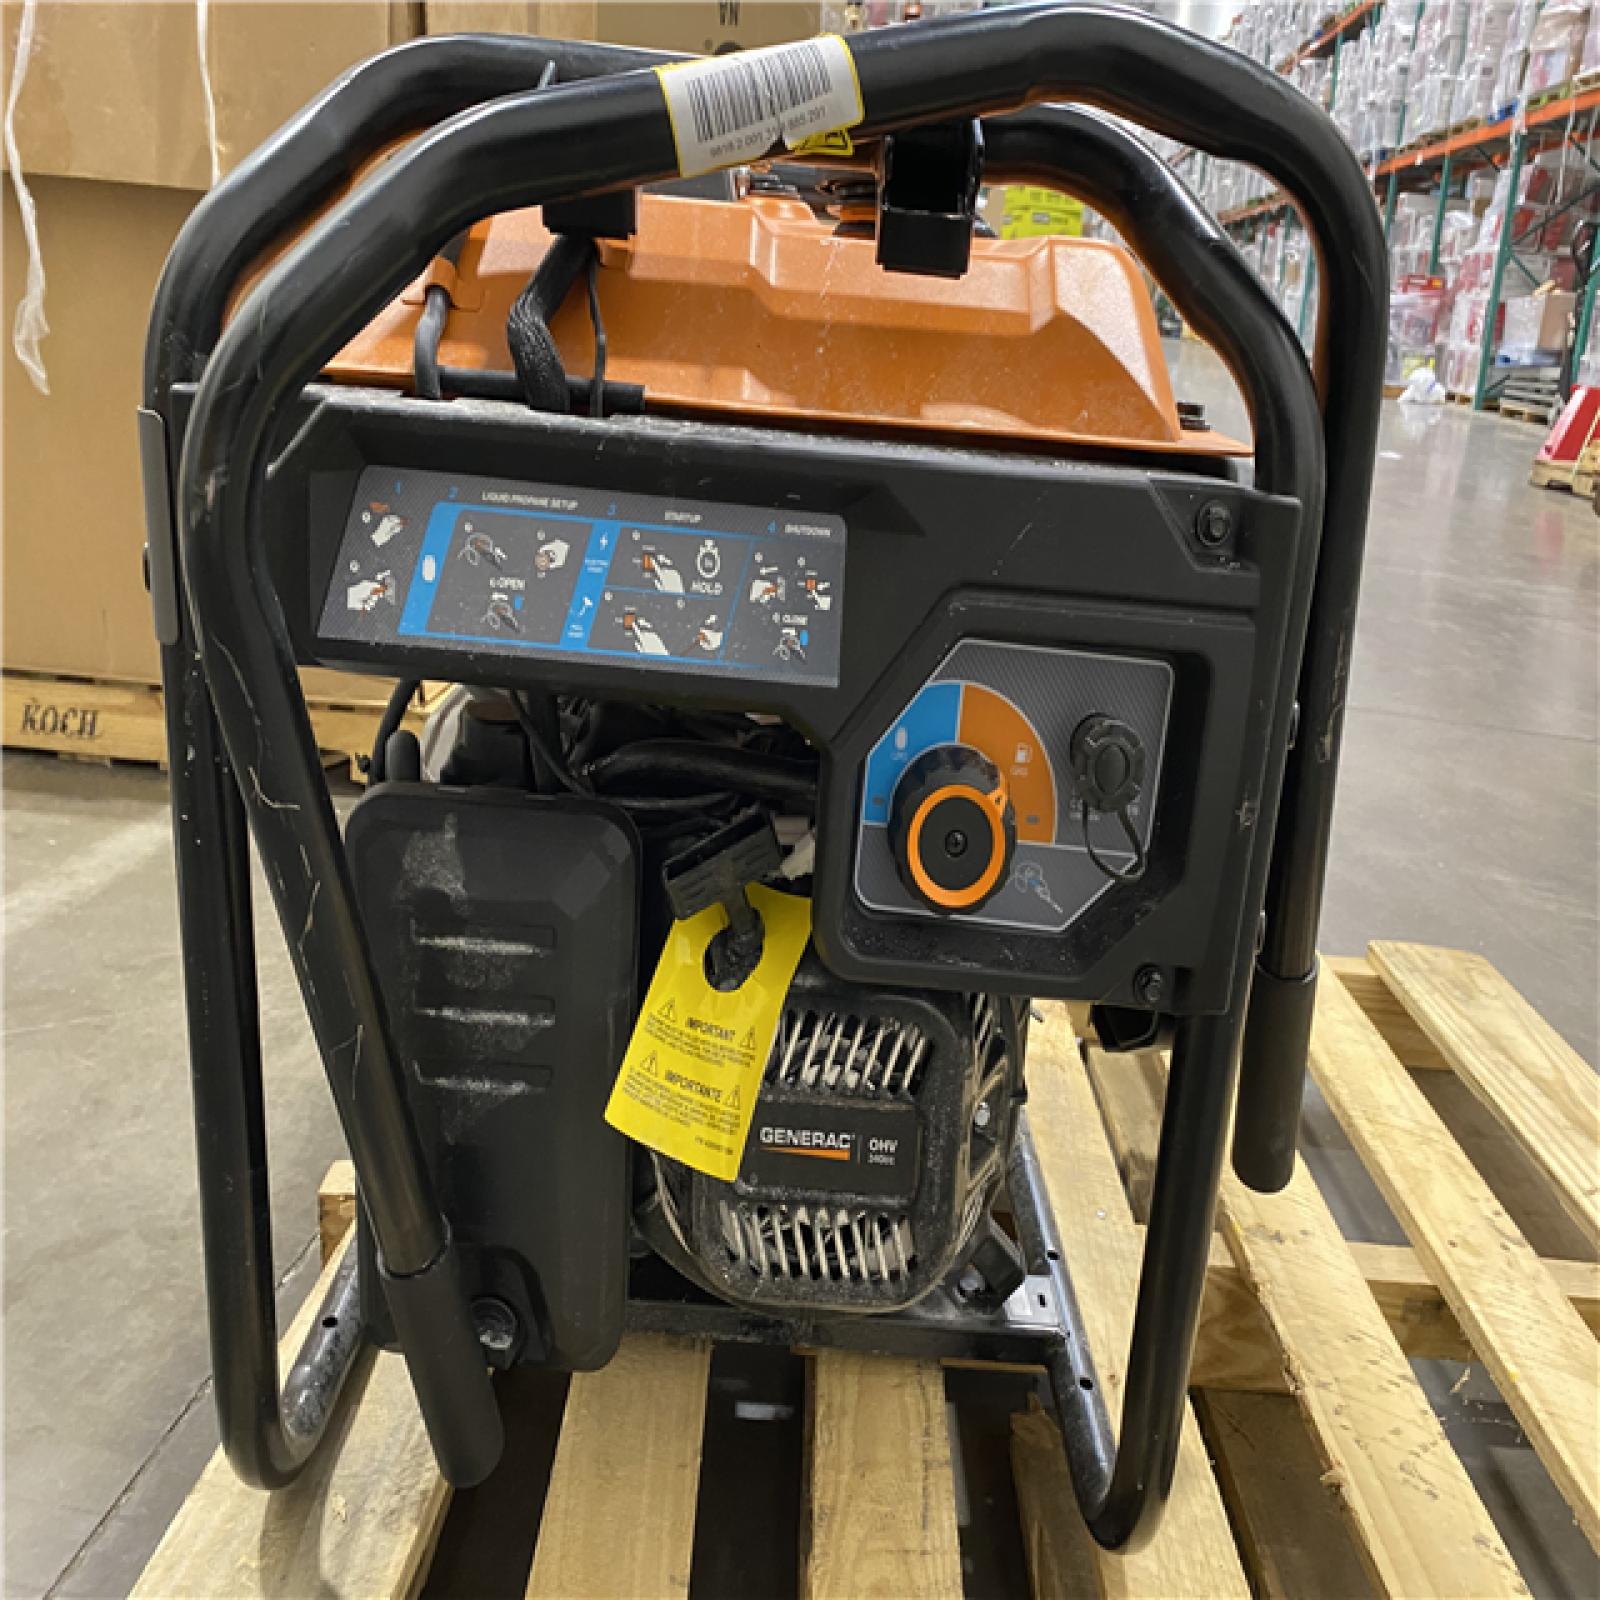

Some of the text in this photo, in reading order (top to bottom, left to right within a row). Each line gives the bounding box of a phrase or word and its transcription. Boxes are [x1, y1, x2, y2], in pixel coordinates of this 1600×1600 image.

[482, 490, 510, 504] LIQUID
[511, 493, 549, 508] PROPANE
[551, 496, 579, 511] SETUP
[664, 510, 703, 524] STARTUP
[691, 580, 723, 596] HOLD
[21, 704, 99, 738] KOCH
[684, 1017, 736, 1040] IMPORTANT
[664, 1069, 723, 1103] IMPORTANTE
[759, 1127, 851, 1149] GENERAC
[869, 1137, 899, 1153] OHV
